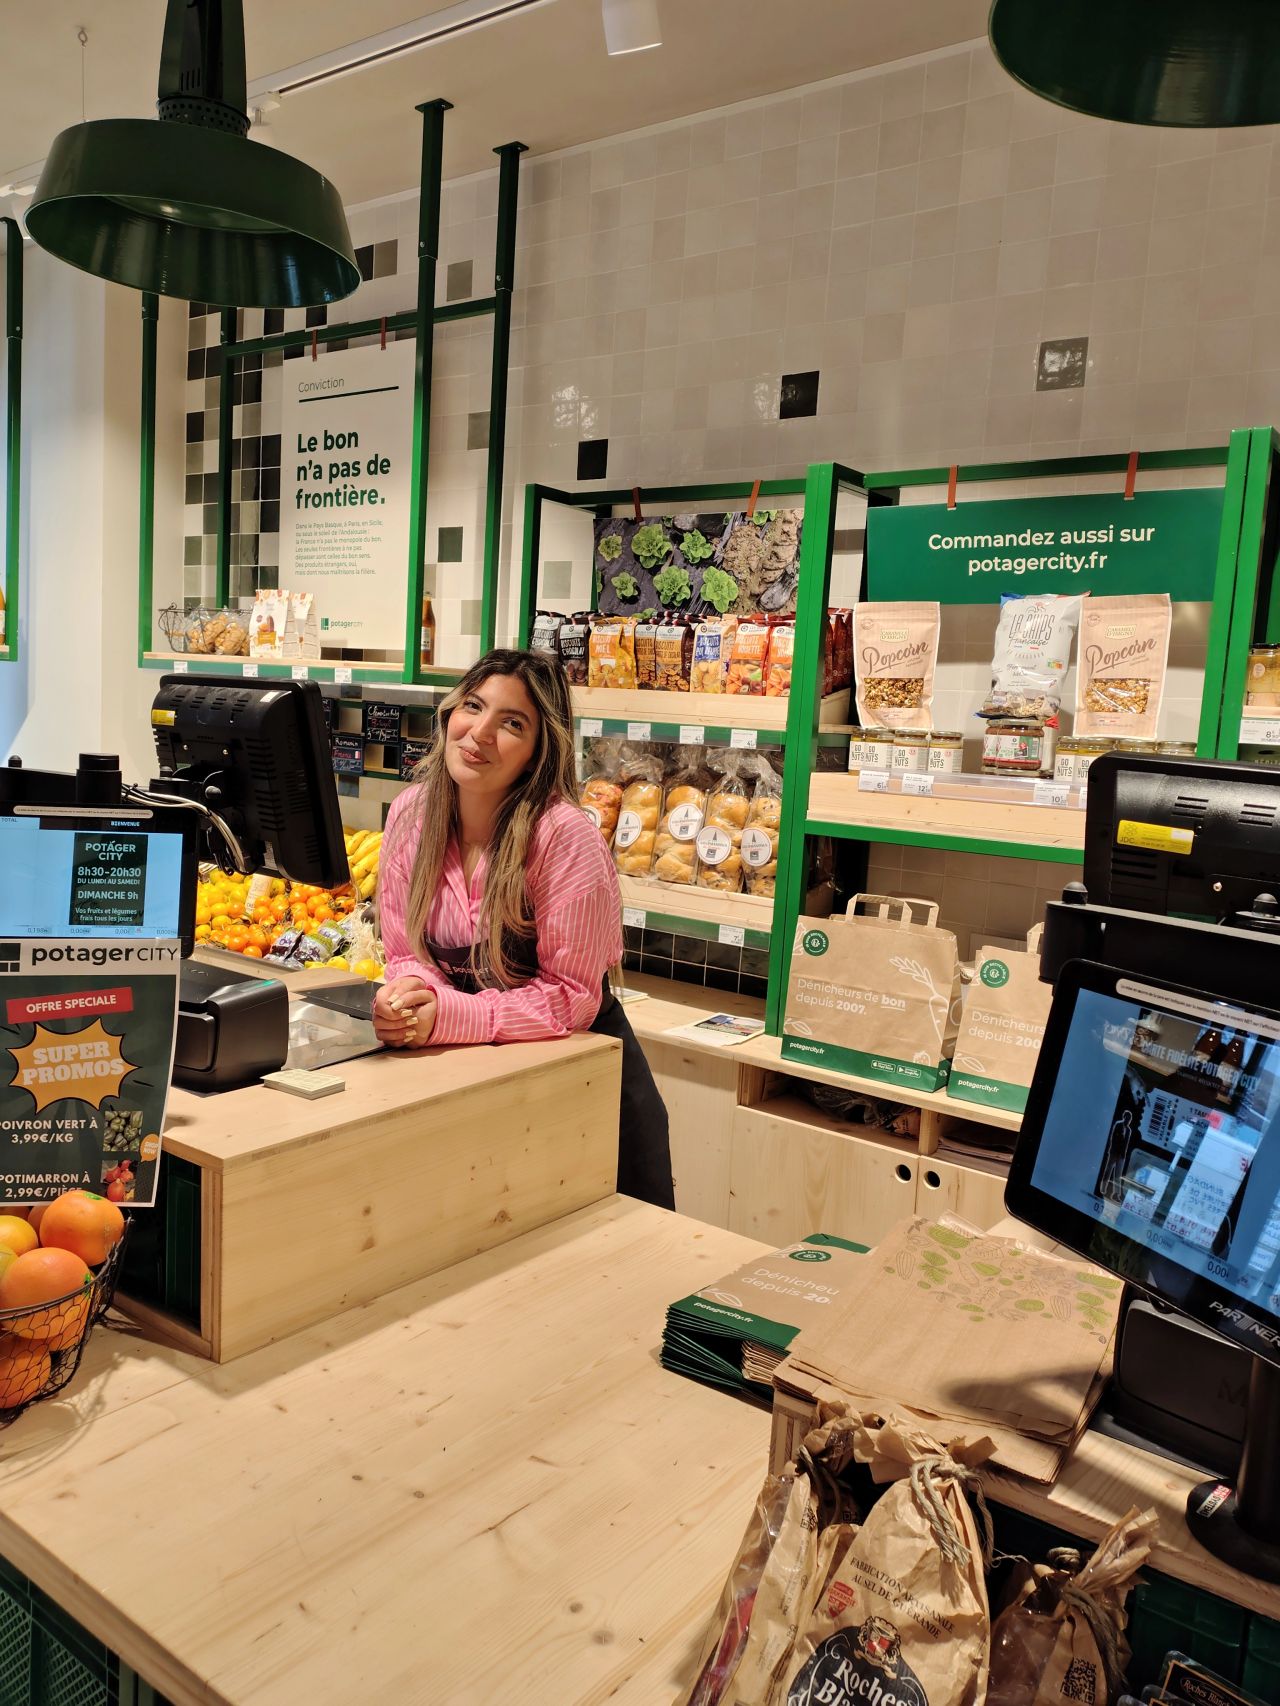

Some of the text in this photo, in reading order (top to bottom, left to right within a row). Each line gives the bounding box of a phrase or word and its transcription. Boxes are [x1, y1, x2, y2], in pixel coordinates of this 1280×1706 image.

[298, 377, 345, 393] Conviction
[297, 429, 359, 454] Le bon
[329, 460, 361, 484] pas
[366, 453, 391, 476] de
[295, 483, 386, 510] frontière.
[928, 525, 1155, 551] Commandez aussi sur
[968, 551, 1108, 577] potagercity.fr
[862, 641, 929, 676] Popcorn
[1085, 638, 1157, 677] Popcorn
[1060, 758, 1069, 766] GO
[98, 852, 124, 861] CITY
[77, 890, 139, 900] DIMANCHE 9h
[87, 907, 104, 915] fruits
[111, 908, 138, 917] légumes
[117, 915, 133, 923] jours
[26, 995, 117, 1014] OFFRE SPECIALE
[795, 992, 868, 1015] depuis 2007.
[864, 992, 879, 1003] de
[881, 994, 906, 1009] bon
[972, 1010, 1046, 1035] Dénicheurs
[789, 1041, 825, 1055] potagercity.fr
[969, 1026, 1042, 1050] depuis 200
[33, 1041, 111, 1065] SUPER
[22, 1058, 125, 1086] PROMOS
[1167, 1047, 1201, 1072] FIDÉLITÉ
[1201, 1060, 1241, 1085] POTAGER
[958, 1079, 1000, 1094] potagercity.fr
[56, 1119, 86, 1130] VERT
[89, 1117, 98, 1129] À
[11, 1133, 74, 1144] 3,99€/KG
[83, 1171, 91, 1184] À
[5, 1185, 83, 1198] 2,99€/PIÈ
[741, 1275, 832, 1305] depuis 20
[753, 1268, 840, 1297] Dénicheu
[693, 1302, 754, 1323] potagercity.fr
[850, 1557, 903, 1593] FABRICATION
[902, 1590, 955, 1634] ARTISANALE
[864, 1579, 877, 1593] SEL
[878, 1586, 893, 1601] DE
